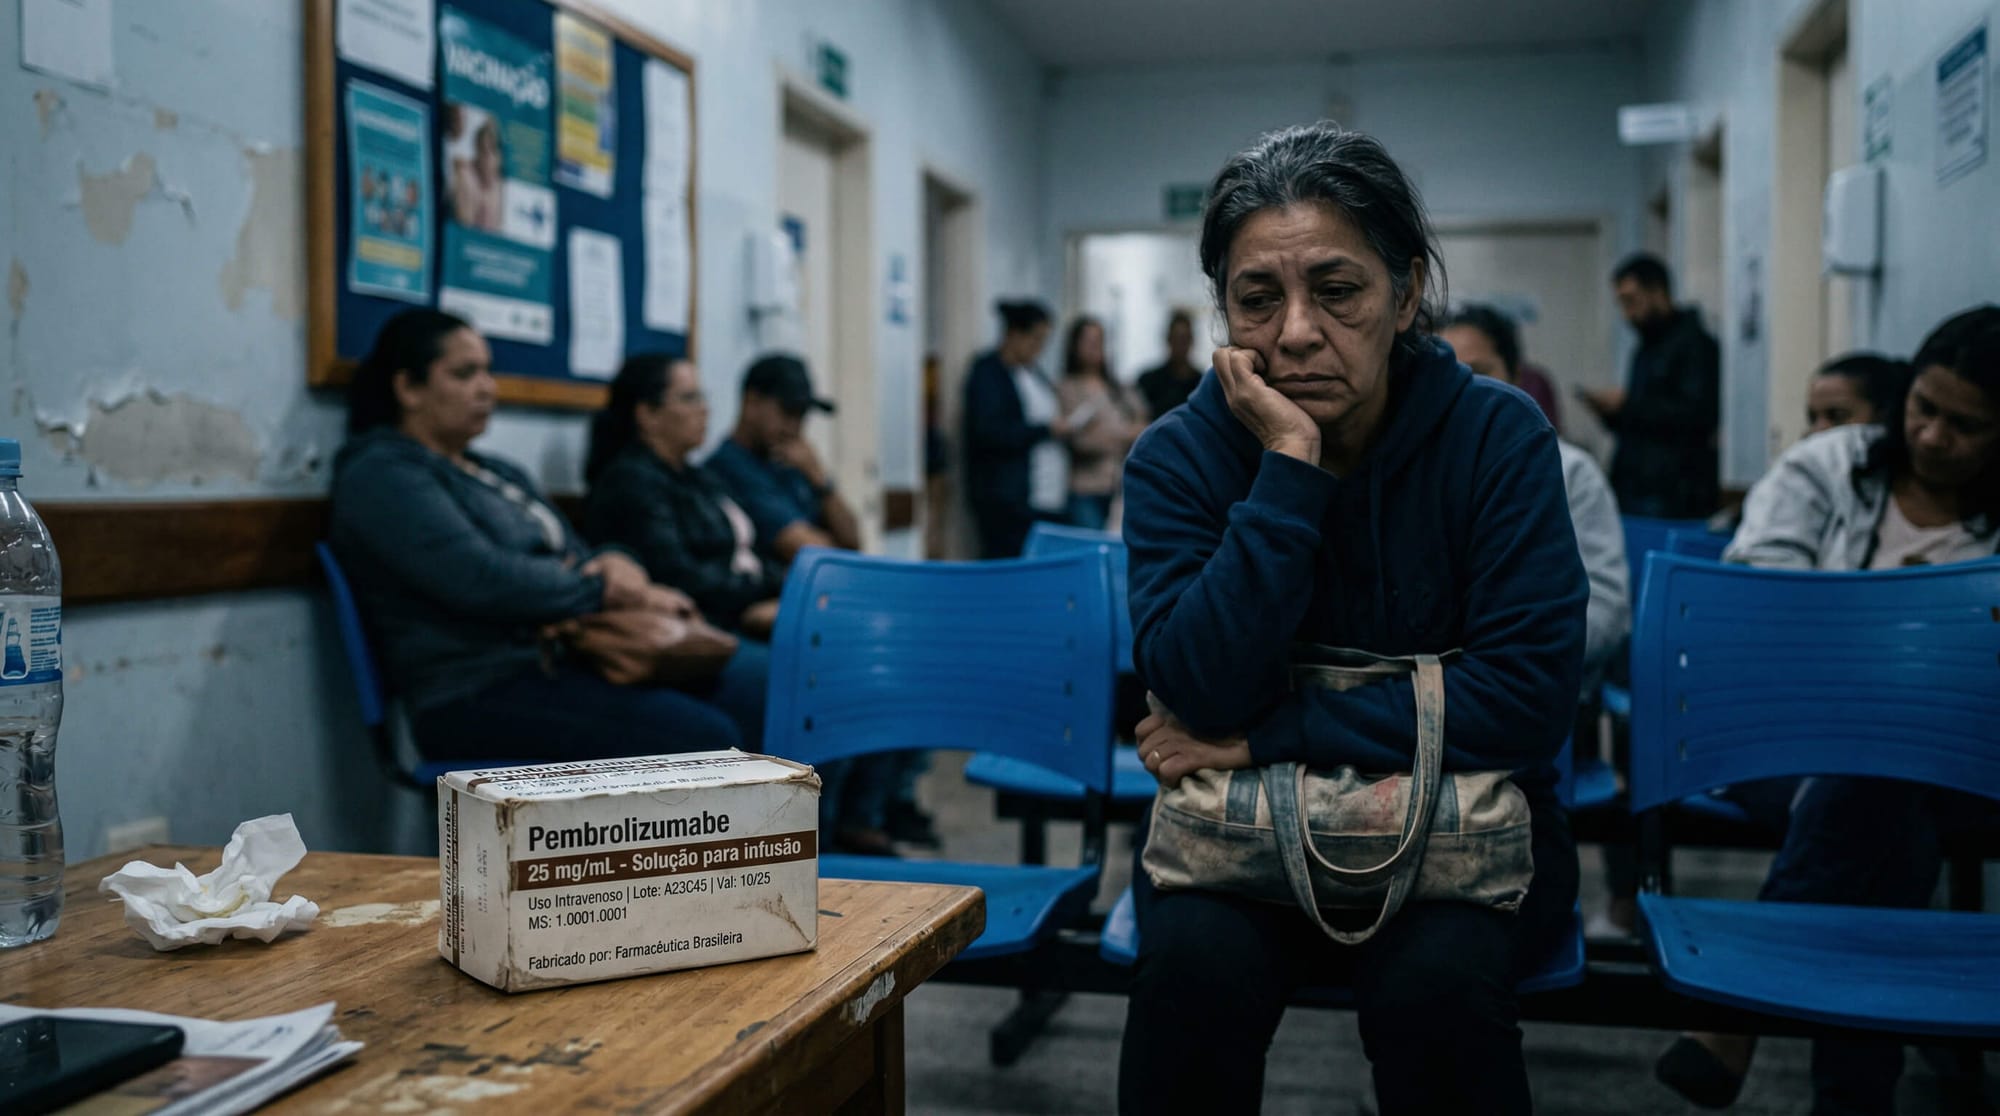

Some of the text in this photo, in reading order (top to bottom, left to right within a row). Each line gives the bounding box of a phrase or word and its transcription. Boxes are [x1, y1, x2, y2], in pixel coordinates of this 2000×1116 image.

[529, 811, 729, 851] Pembrolizumabe
[528, 863, 549, 883] 25
[556, 860, 614, 882] mg/mL
[632, 849, 698, 873] Solução
[703, 847, 739, 867] para
[744, 838, 800, 860] infusão
[528, 896, 550, 910] Uso
[555, 890, 623, 907] Intravenoso
[633, 884, 661, 899] Lote:
[664, 879, 707, 896] A23C45
[717, 876, 736, 890] Val:
[740, 872, 770, 888] 10/25
[528, 907, 627, 930] MS: 1.0001.0001
[529, 953, 585, 970] Fabricado
[590, 950, 611, 965] por:
[693, 931, 742, 949] Brasileira
